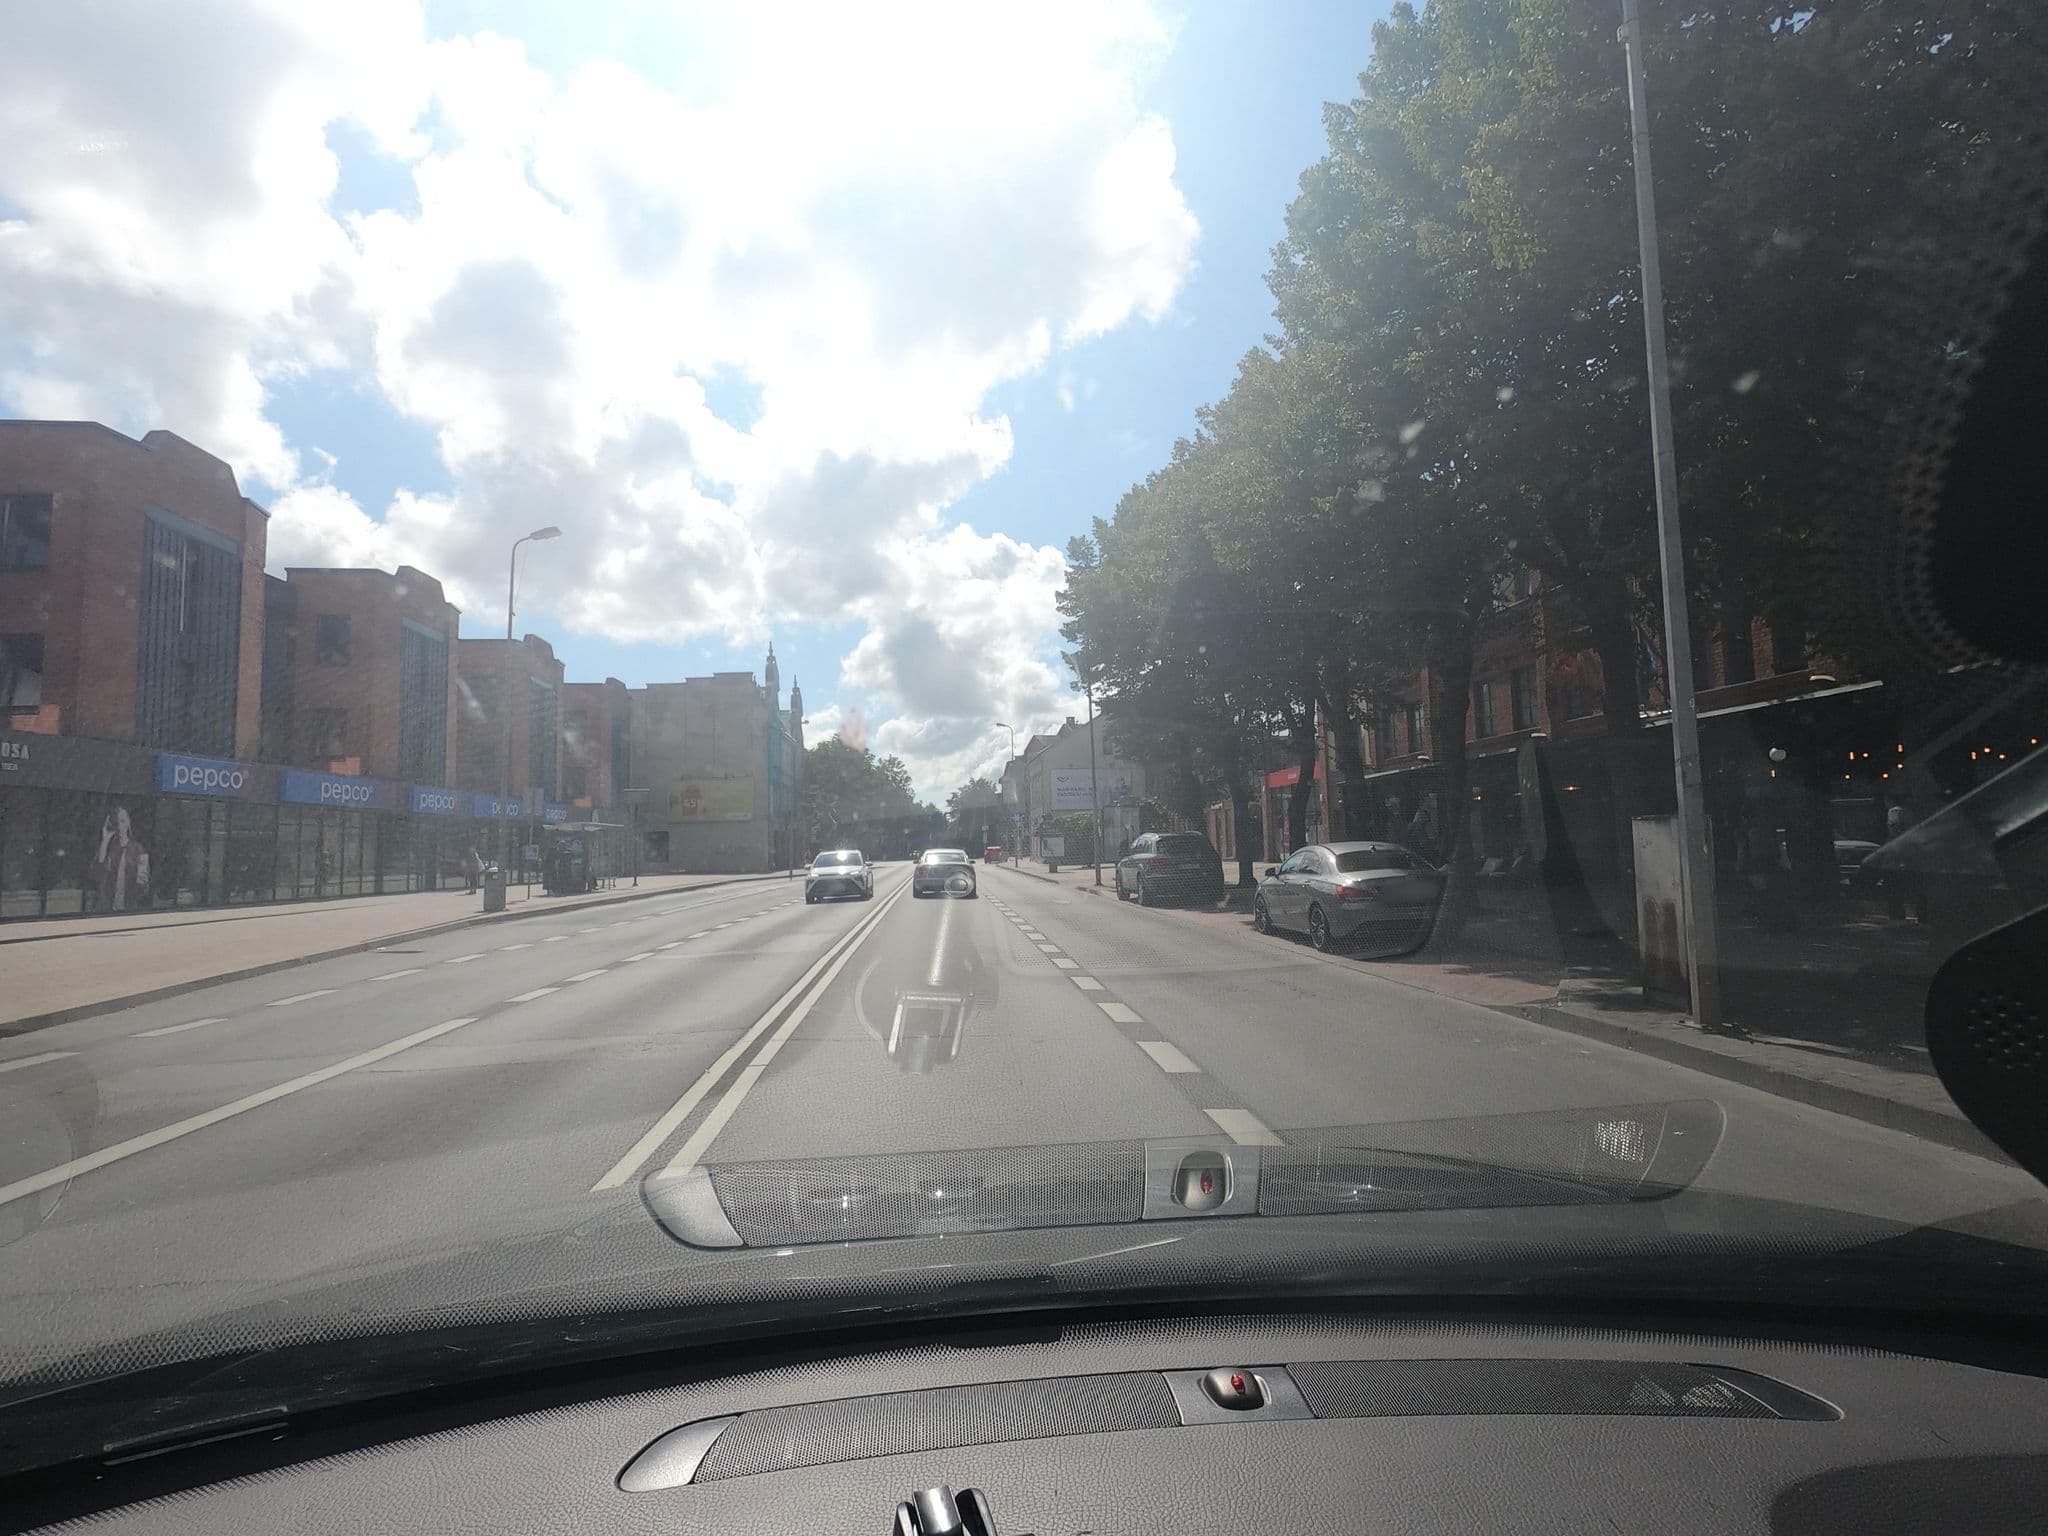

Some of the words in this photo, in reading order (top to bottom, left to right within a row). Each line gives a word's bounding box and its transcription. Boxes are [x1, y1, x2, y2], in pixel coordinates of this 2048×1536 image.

[174, 764, 243, 791] pepco
[320, 782, 370, 803] pepco
[420, 792, 455, 811] pepco
